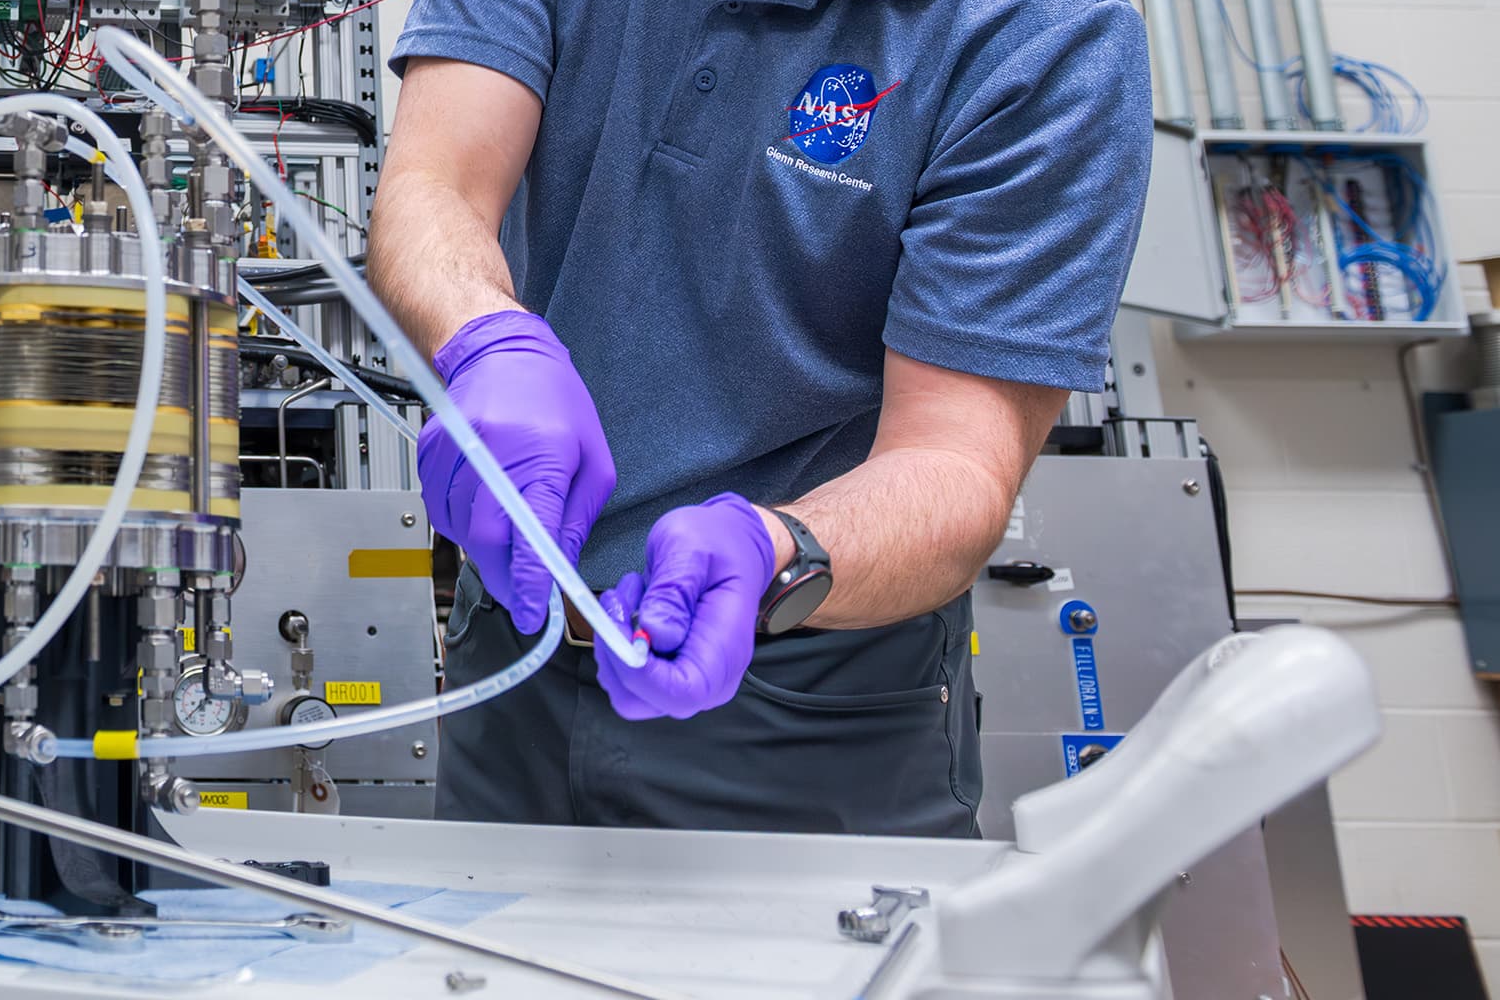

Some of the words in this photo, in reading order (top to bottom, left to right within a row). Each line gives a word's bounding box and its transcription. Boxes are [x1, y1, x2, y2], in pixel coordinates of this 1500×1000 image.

[797, 91, 870, 132] NASA
[766, 146, 794, 166] Glenn
[794, 158, 838, 182] Research
[838, 172, 874, 192] Center
[329, 684, 376, 701] HR001
